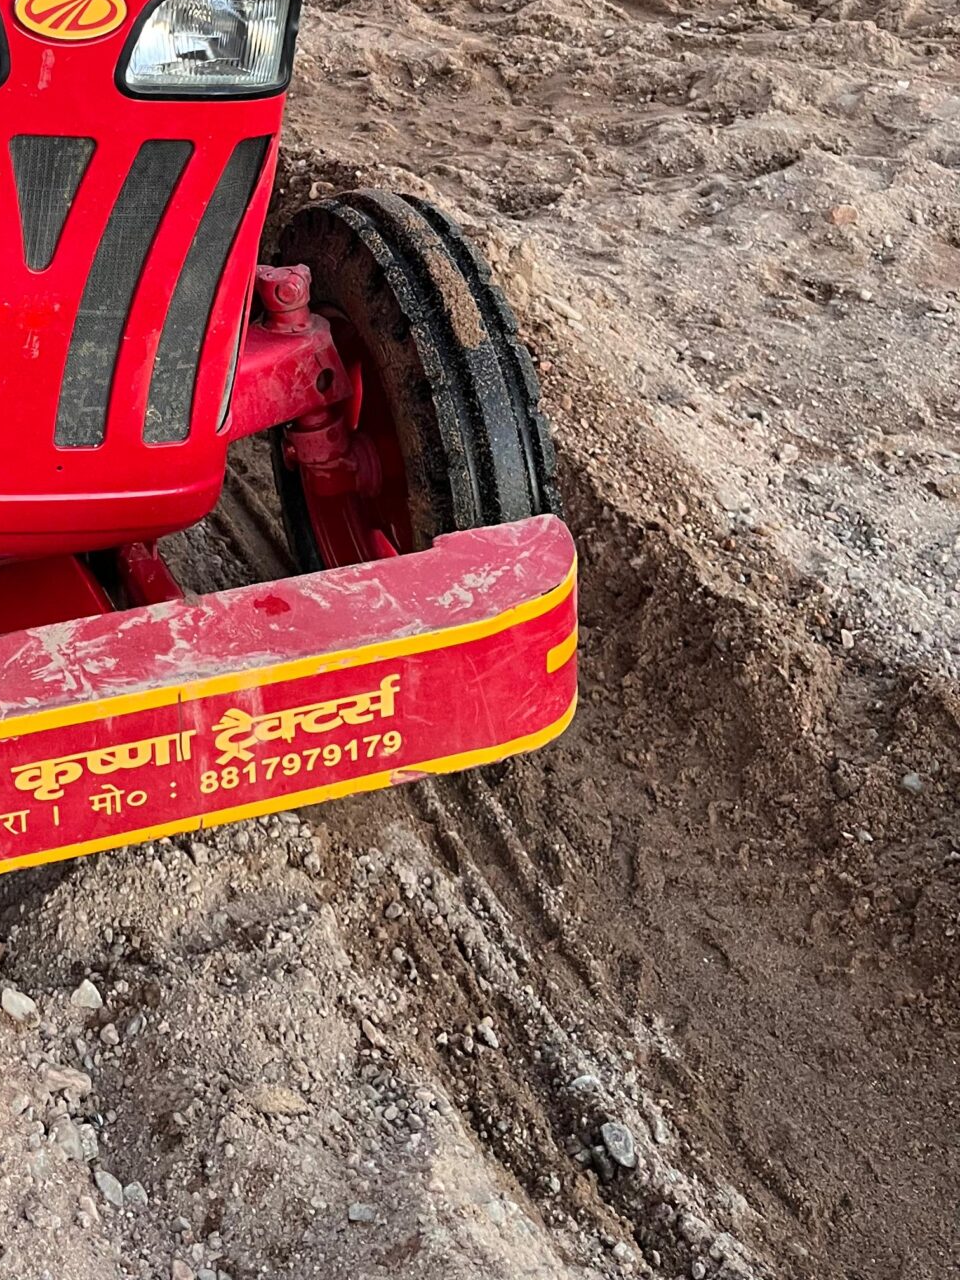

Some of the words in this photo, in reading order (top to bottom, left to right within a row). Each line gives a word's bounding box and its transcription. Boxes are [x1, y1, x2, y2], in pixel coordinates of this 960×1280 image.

[10, 729, 197, 801] कृष्णा
[211, 673, 401, 765] ट्रैक्टर्स
[199, 730, 403, 794] 8817979179
